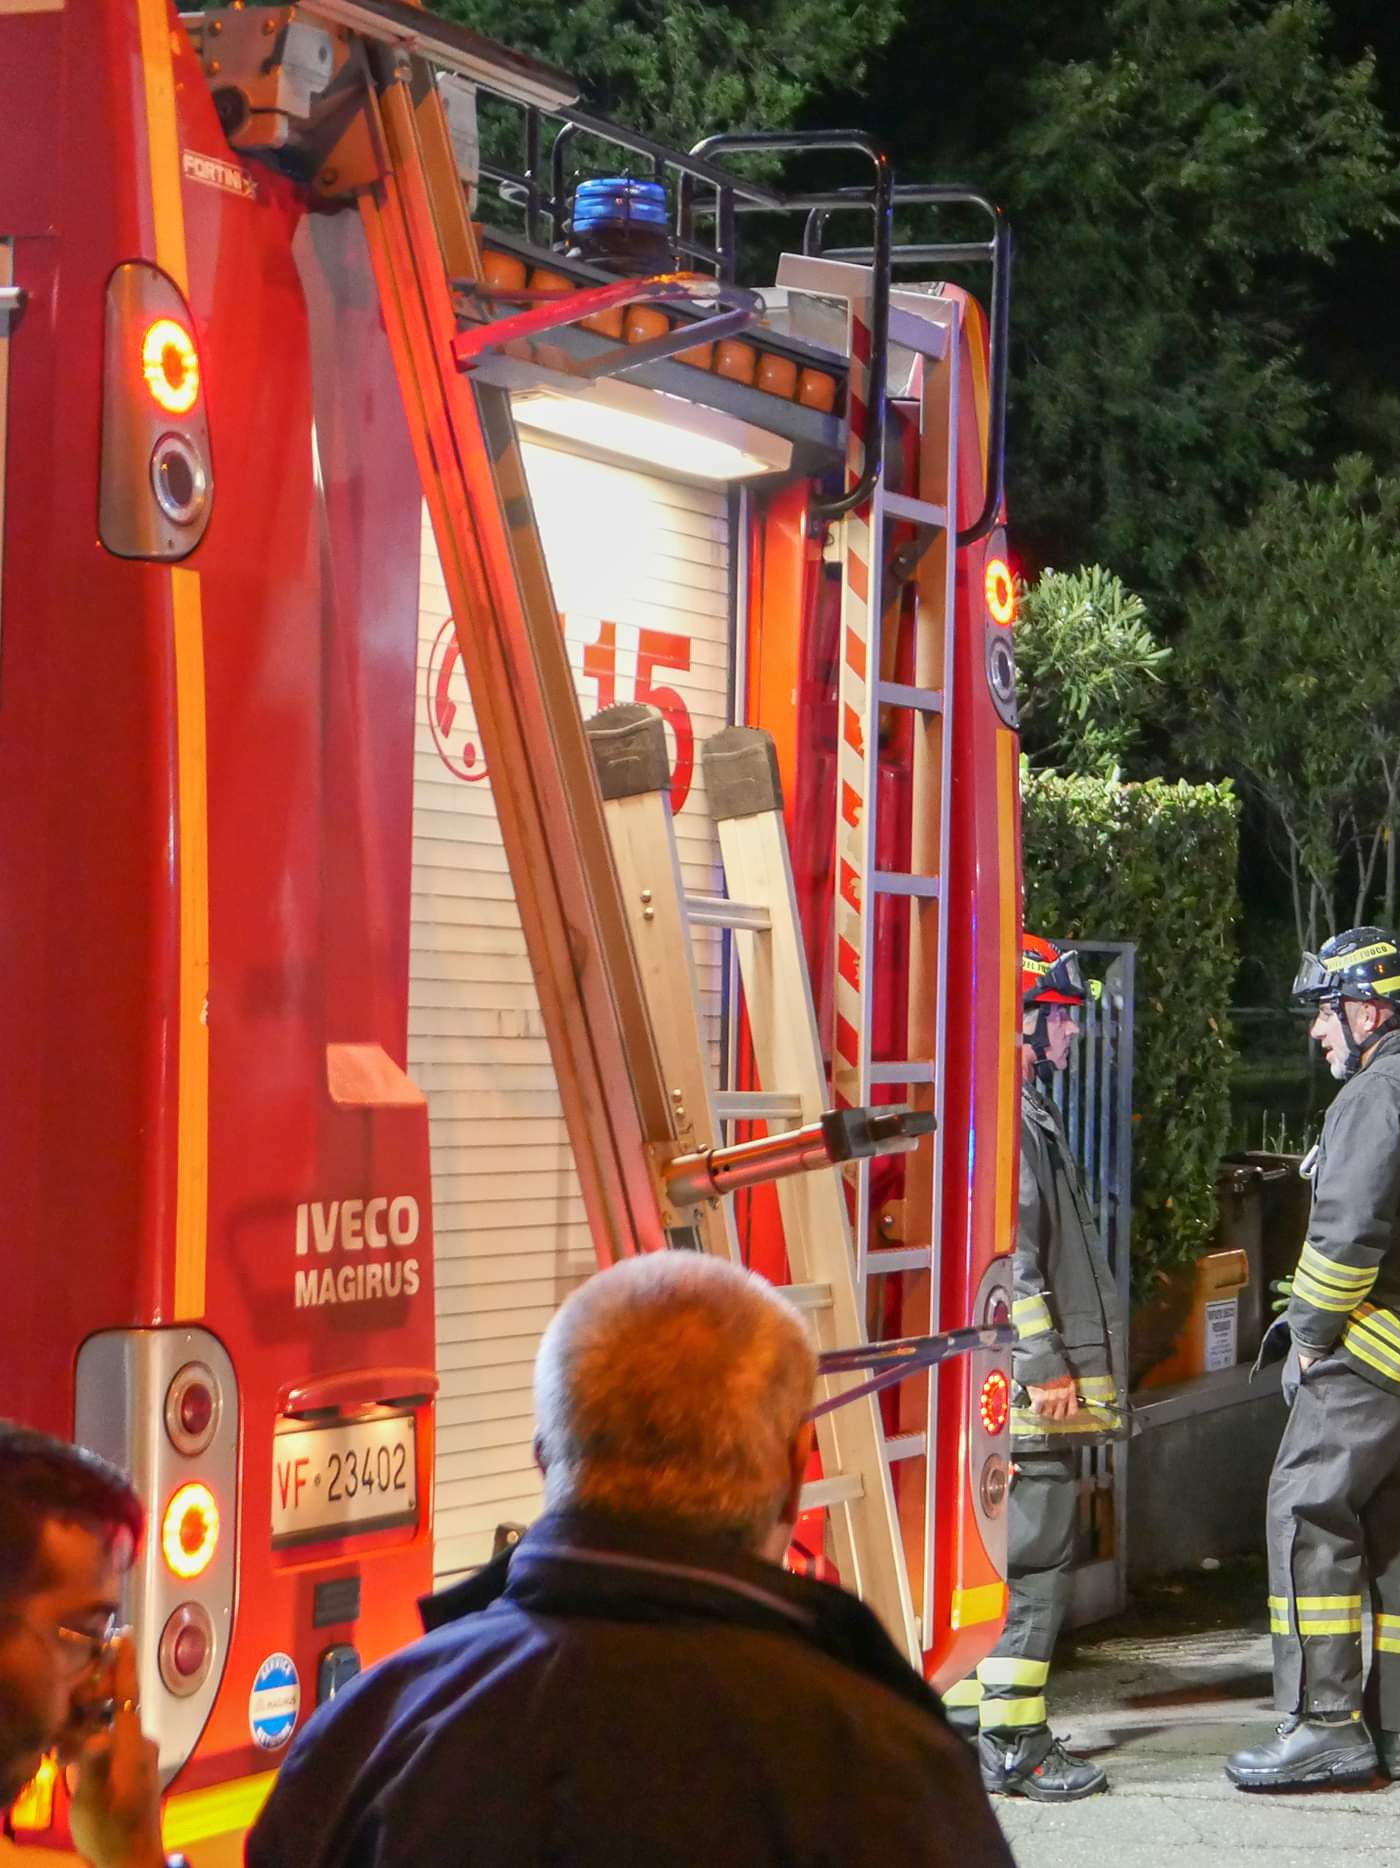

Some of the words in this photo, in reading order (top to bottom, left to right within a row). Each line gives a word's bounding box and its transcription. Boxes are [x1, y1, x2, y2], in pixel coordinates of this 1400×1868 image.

[295, 1195, 419, 1255] IVECO
[294, 1258, 420, 1308] MAGIRUS
[278, 1458, 309, 1510] VF
[328, 1442, 407, 1502] 23402
